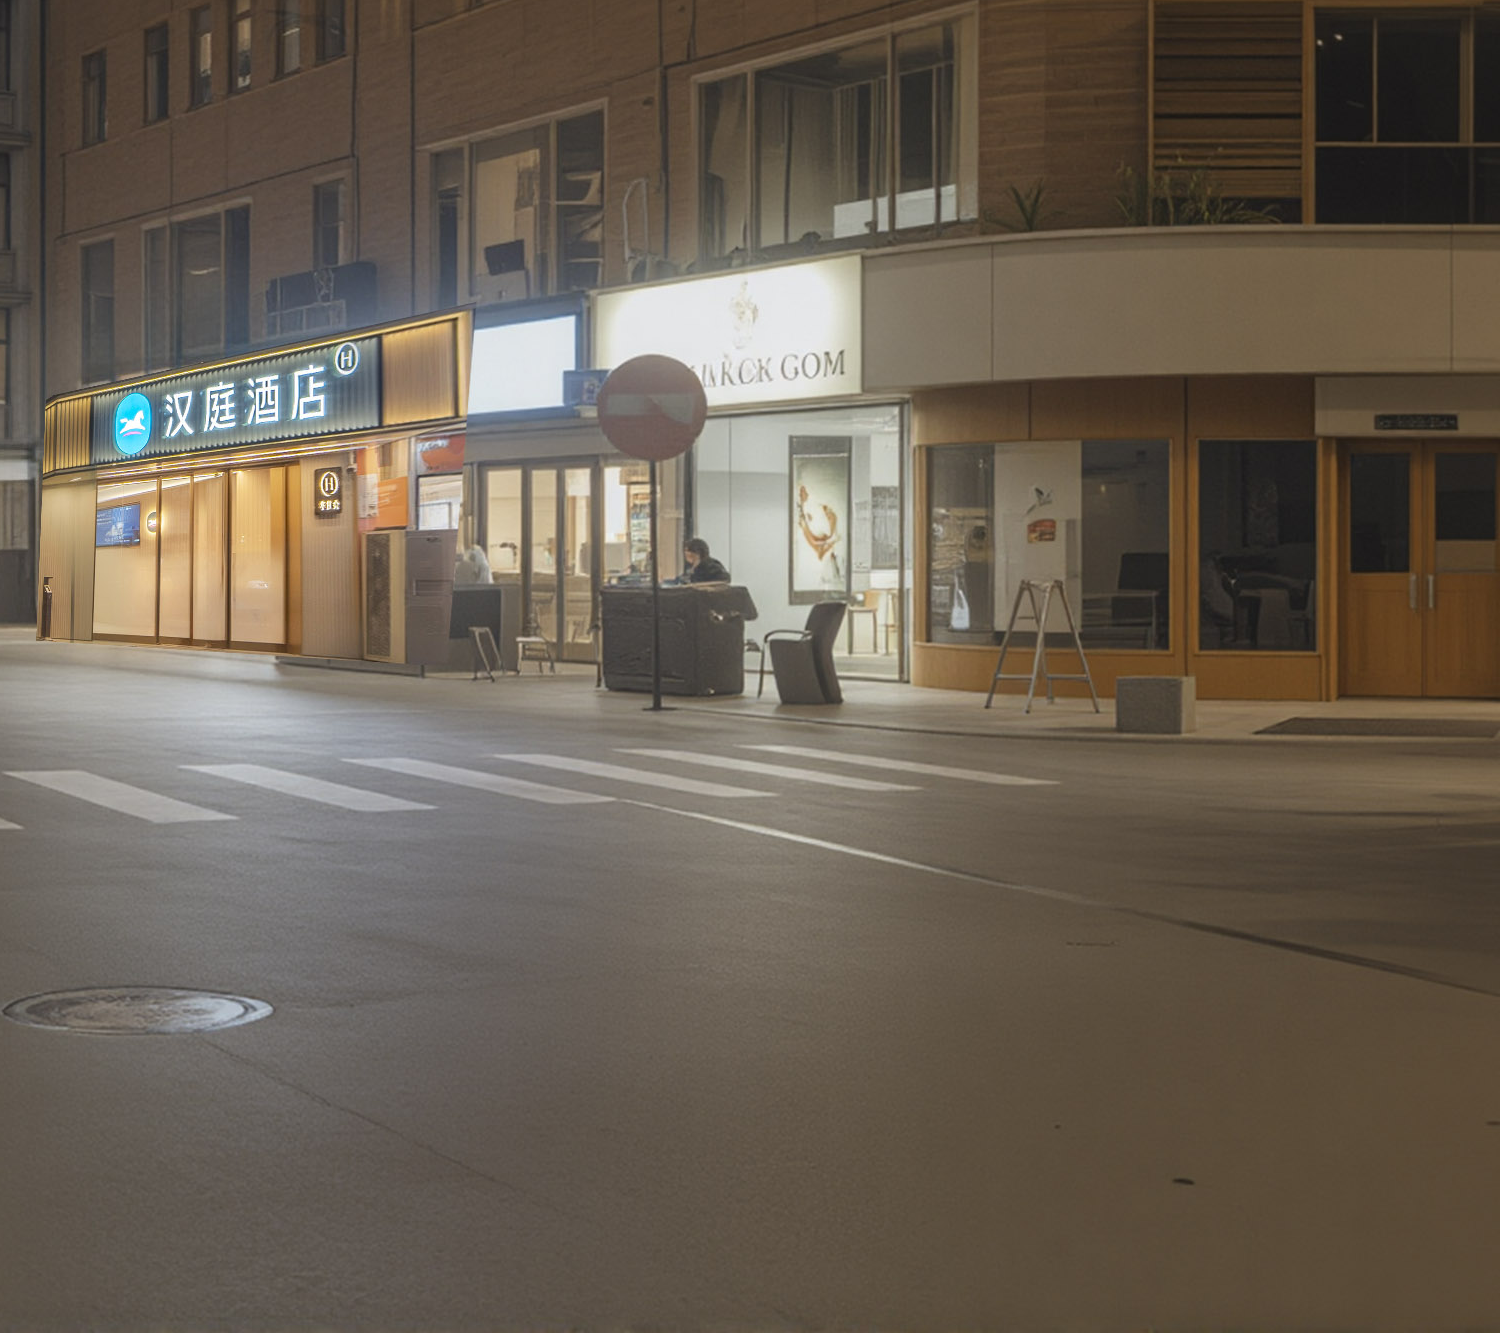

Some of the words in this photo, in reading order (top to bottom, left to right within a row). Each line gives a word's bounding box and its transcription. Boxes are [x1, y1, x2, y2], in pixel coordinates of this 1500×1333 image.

[780, 349, 846, 381] GOM
[165, 364, 326, 438] 汉庭酒店
